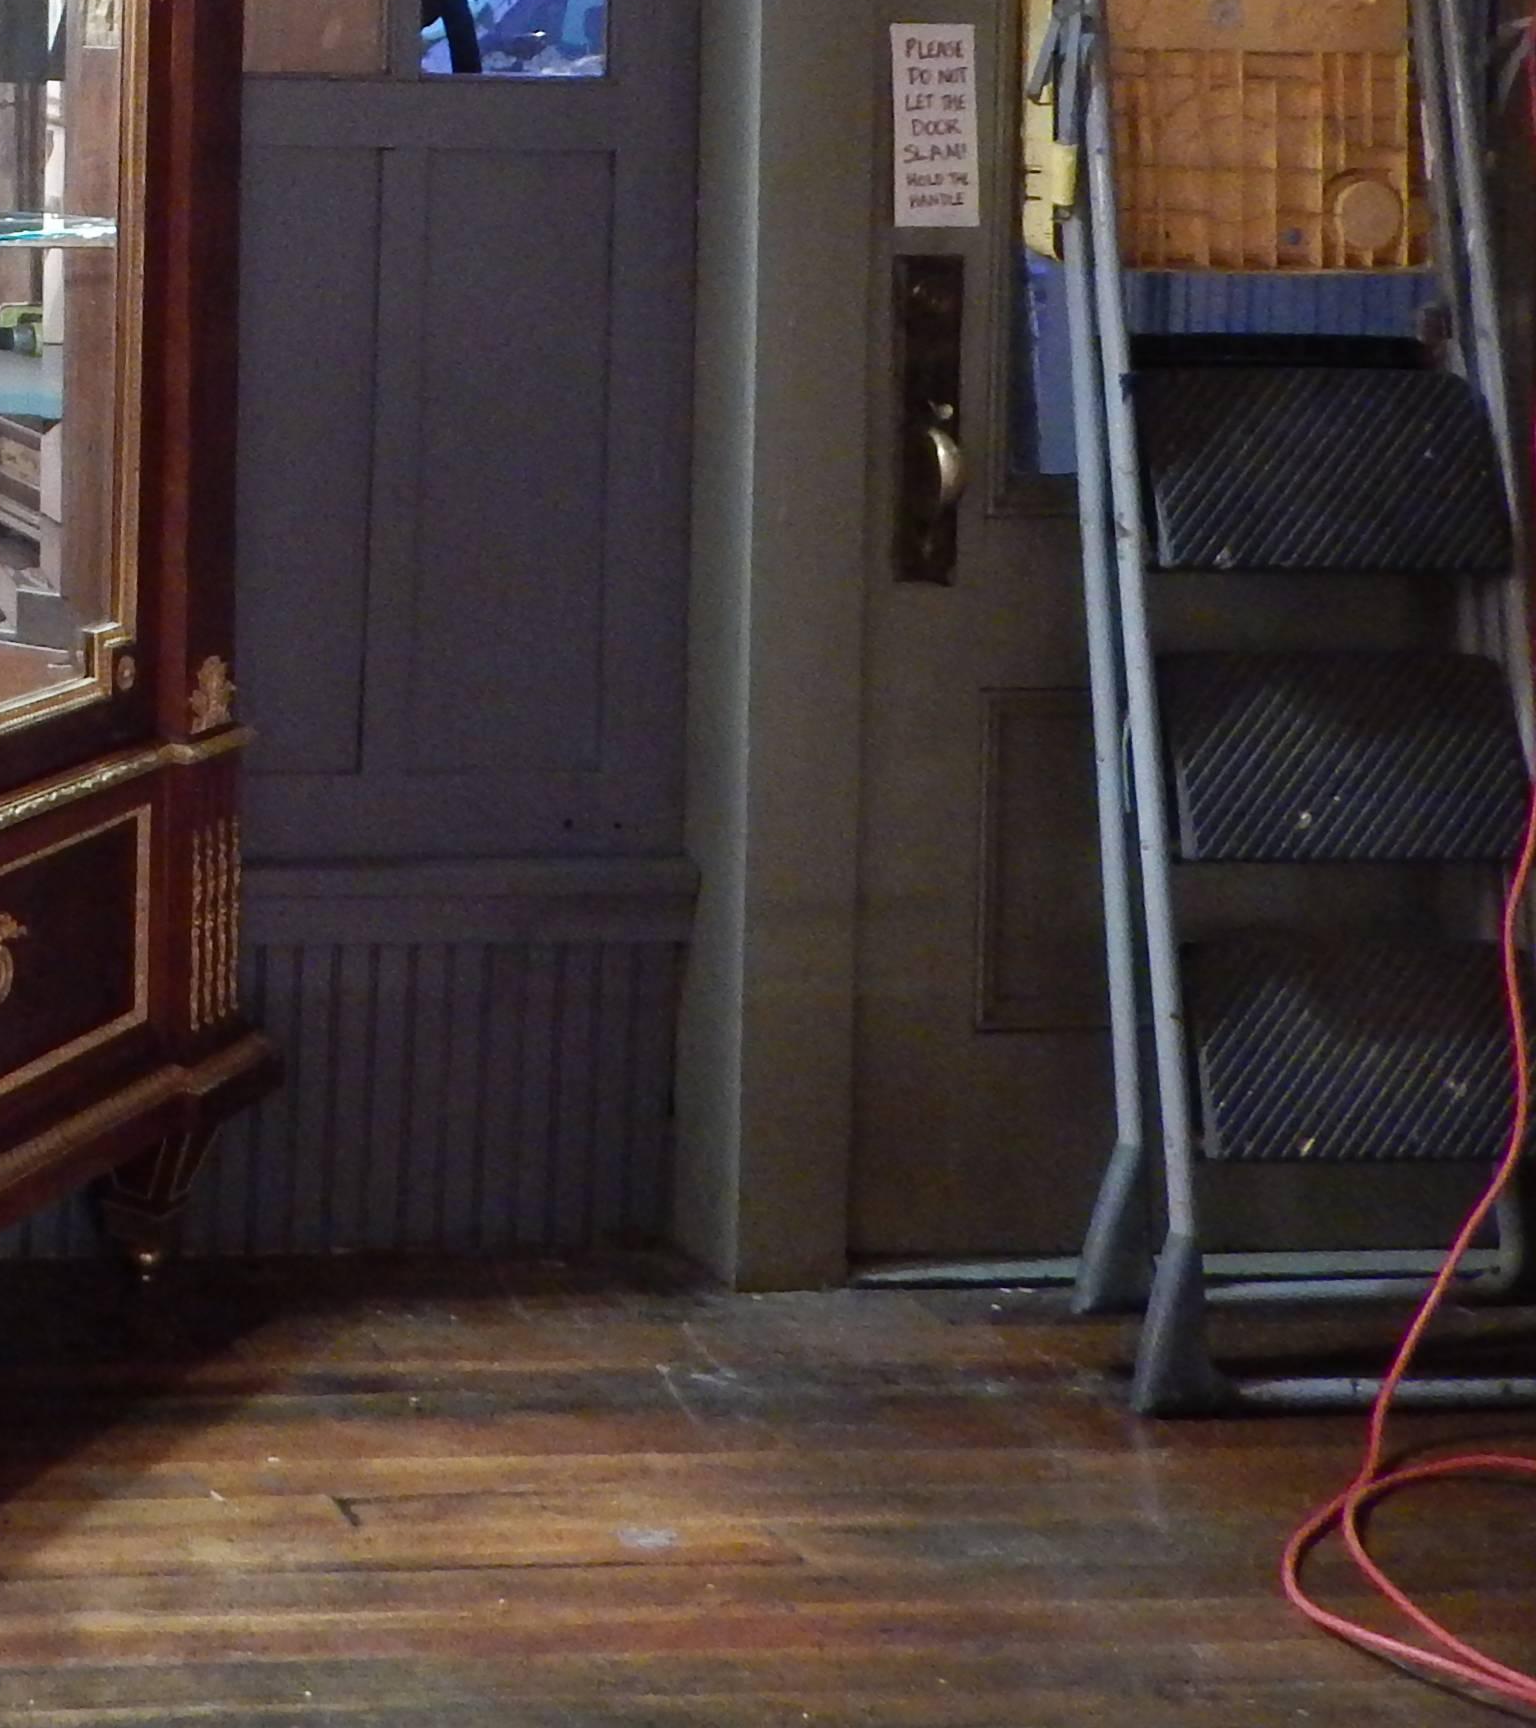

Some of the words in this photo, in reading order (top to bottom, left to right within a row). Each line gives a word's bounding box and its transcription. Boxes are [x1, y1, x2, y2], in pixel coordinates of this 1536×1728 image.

[905, 37, 965, 60] PLEASE
[908, 67, 932, 85] DO
[937, 66, 968, 84] NOT
[905, 93, 934, 112] LET
[941, 94, 966, 111] THE
[911, 119, 962, 137] DOOR
[906, 172, 945, 187] HOLD
[948, 172, 969, 186] THE
[909, 191, 965, 209] HANDLE
